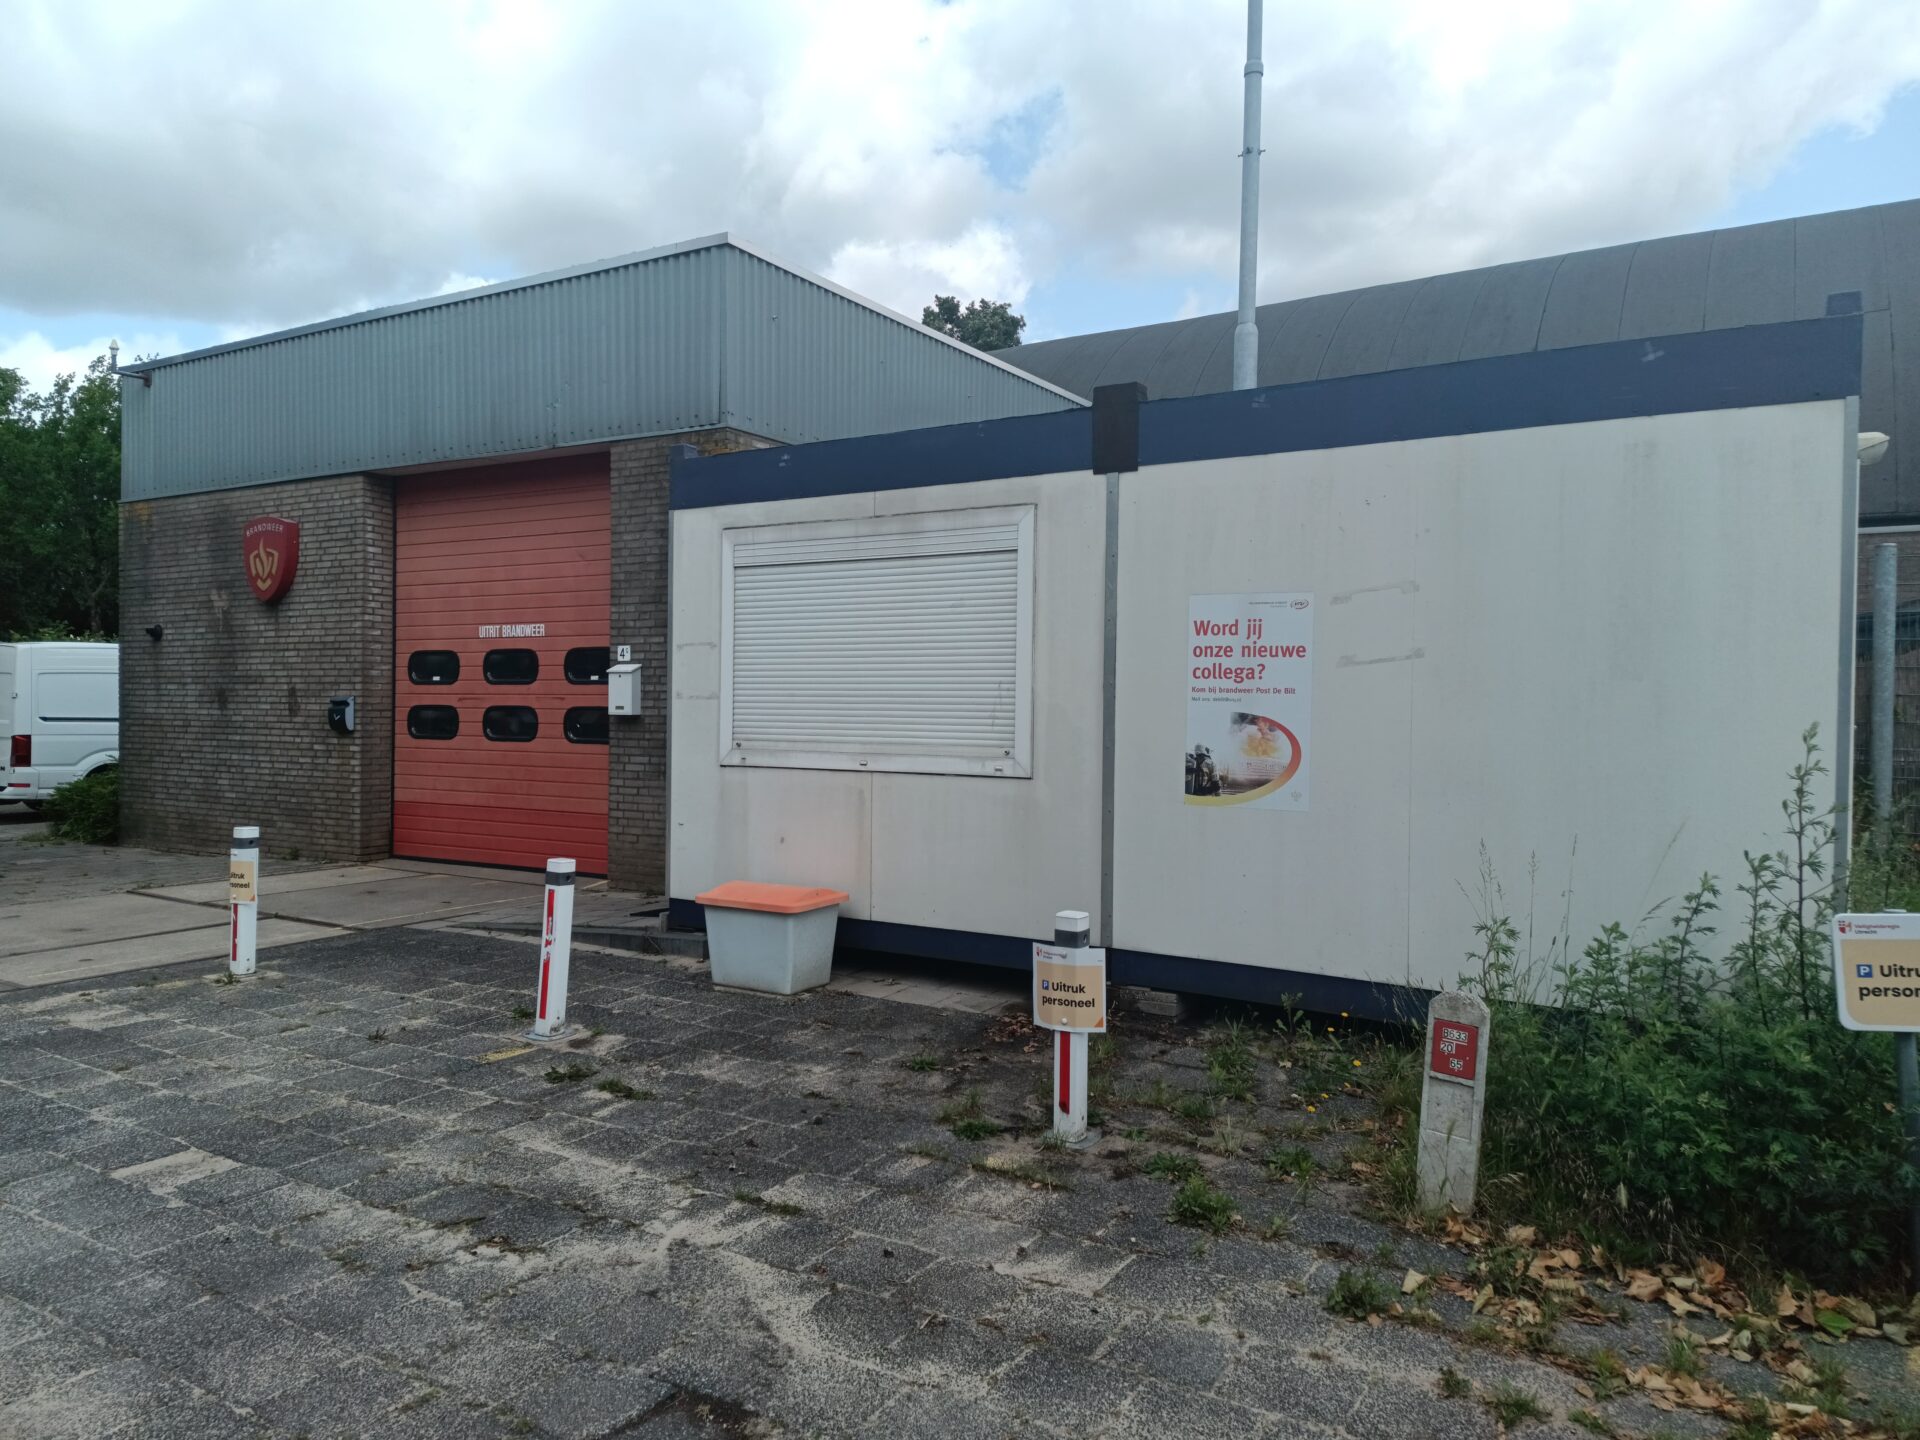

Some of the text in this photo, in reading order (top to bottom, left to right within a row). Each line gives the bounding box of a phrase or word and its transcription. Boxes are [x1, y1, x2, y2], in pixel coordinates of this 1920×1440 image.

[246, 522, 284, 537] BRANDWEER
[479, 623, 545, 638] UITRIT BRANDWEER
[1193, 618, 1263, 640] Word jij
[1192, 640, 1307, 659] onze nieuwe
[1192, 662, 1266, 684] collega?
[1191, 686, 1296, 695] Kom bij brandweer Post De Bilt
[1052, 981, 1086, 994] Uitruk
[1042, 995, 1096, 1008] personeel
